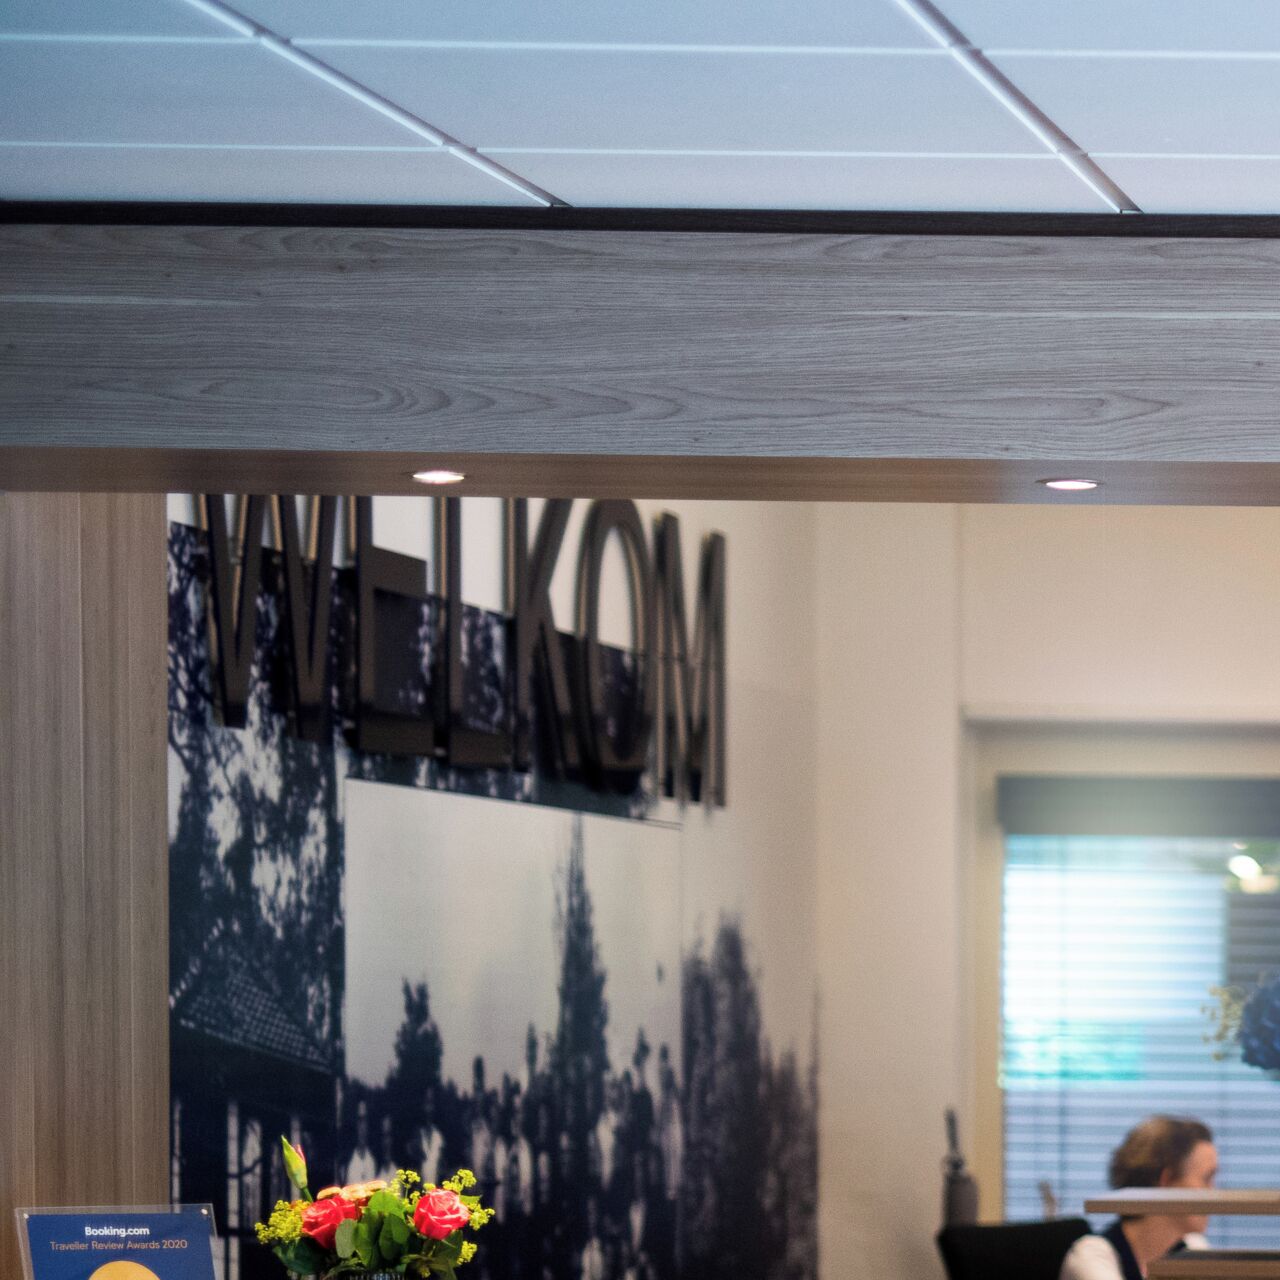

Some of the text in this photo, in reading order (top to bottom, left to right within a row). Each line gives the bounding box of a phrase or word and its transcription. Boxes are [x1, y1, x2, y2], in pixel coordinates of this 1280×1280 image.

[85, 1226, 150, 1238] Booking.com
[50, 1239, 188, 1251] Traveller Review Awards 2020
